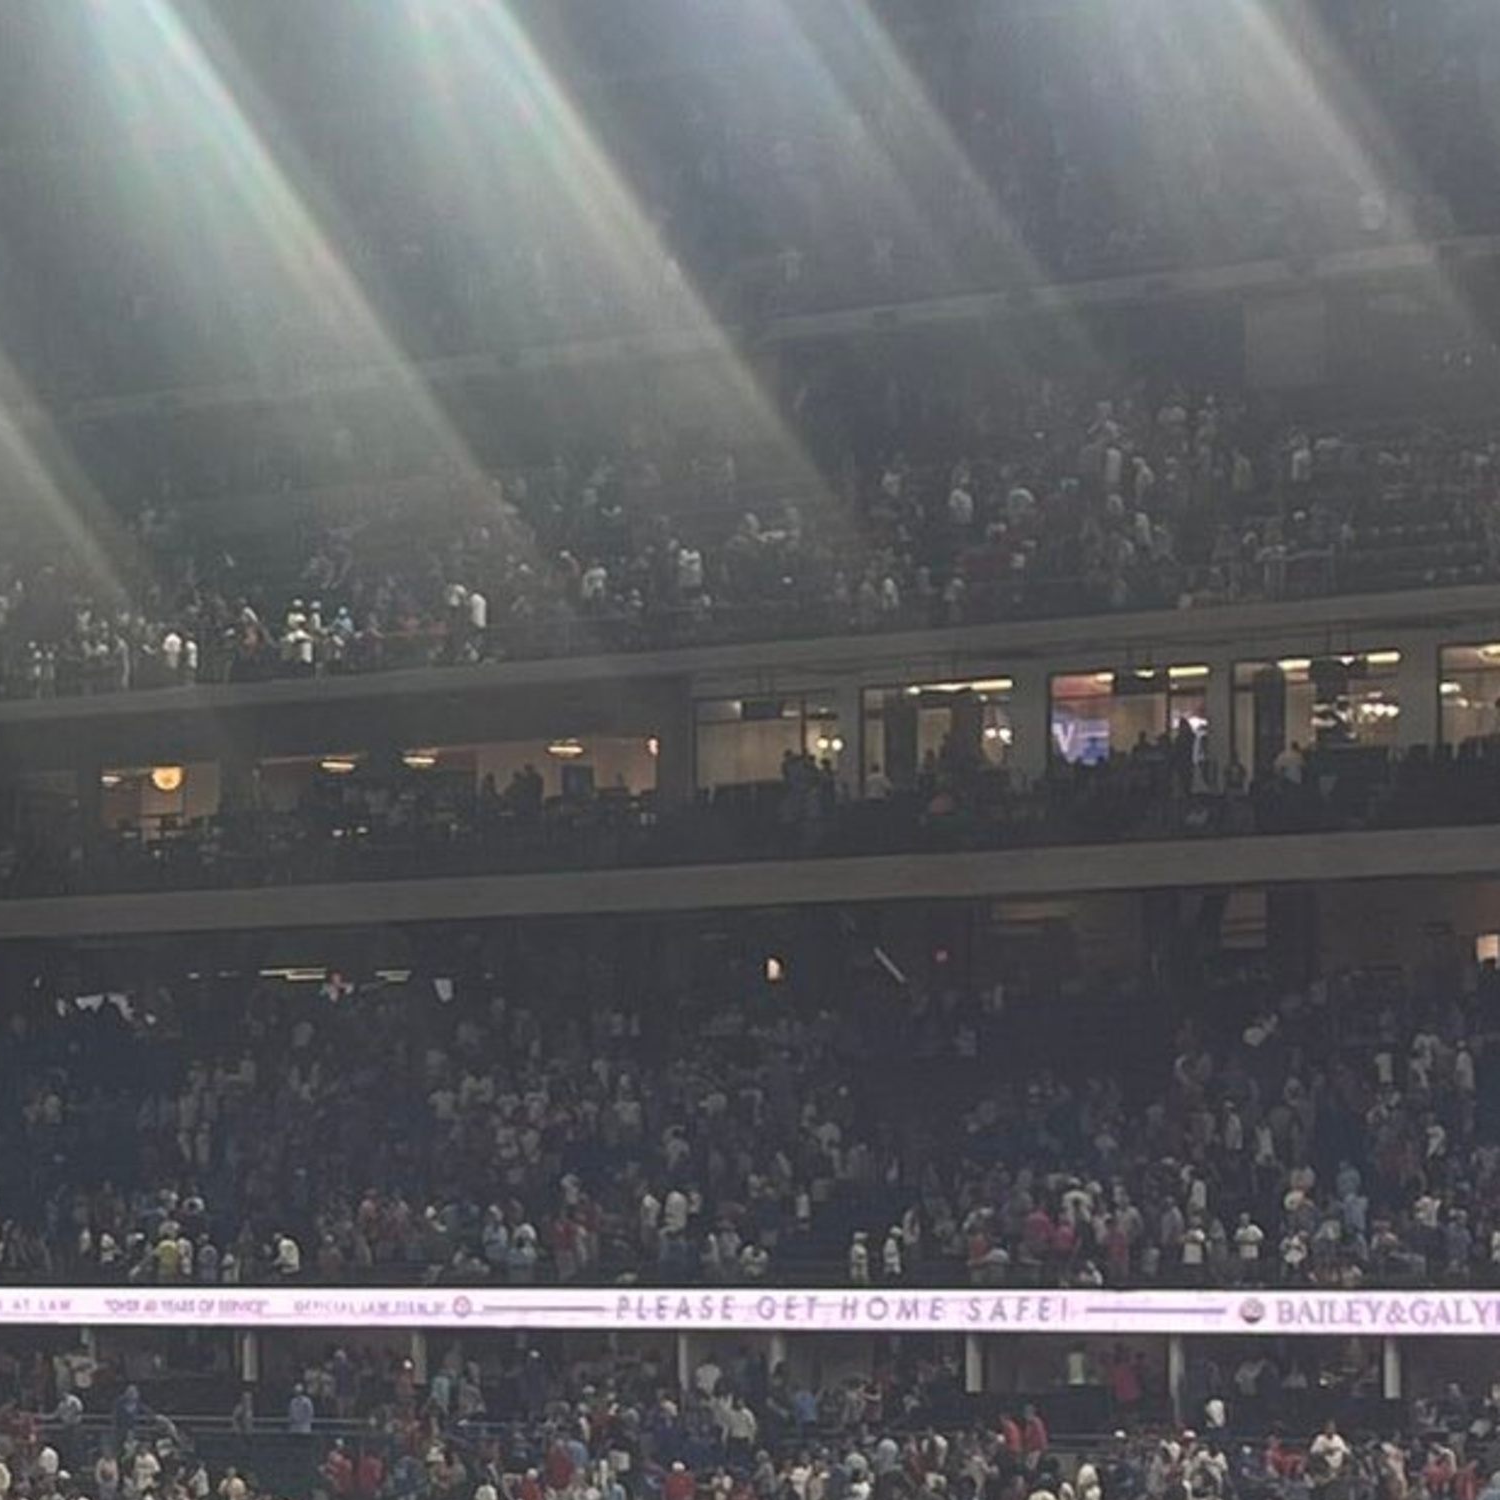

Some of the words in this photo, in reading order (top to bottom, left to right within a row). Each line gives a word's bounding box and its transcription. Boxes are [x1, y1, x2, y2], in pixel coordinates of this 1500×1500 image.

[615, 1295, 735, 1320] PLEASE
[757, 1295, 819, 1320] GET
[840, 1296, 945, 1321] HOME
[1276, 1298, 1500, 1325] BAILEY&GALY
